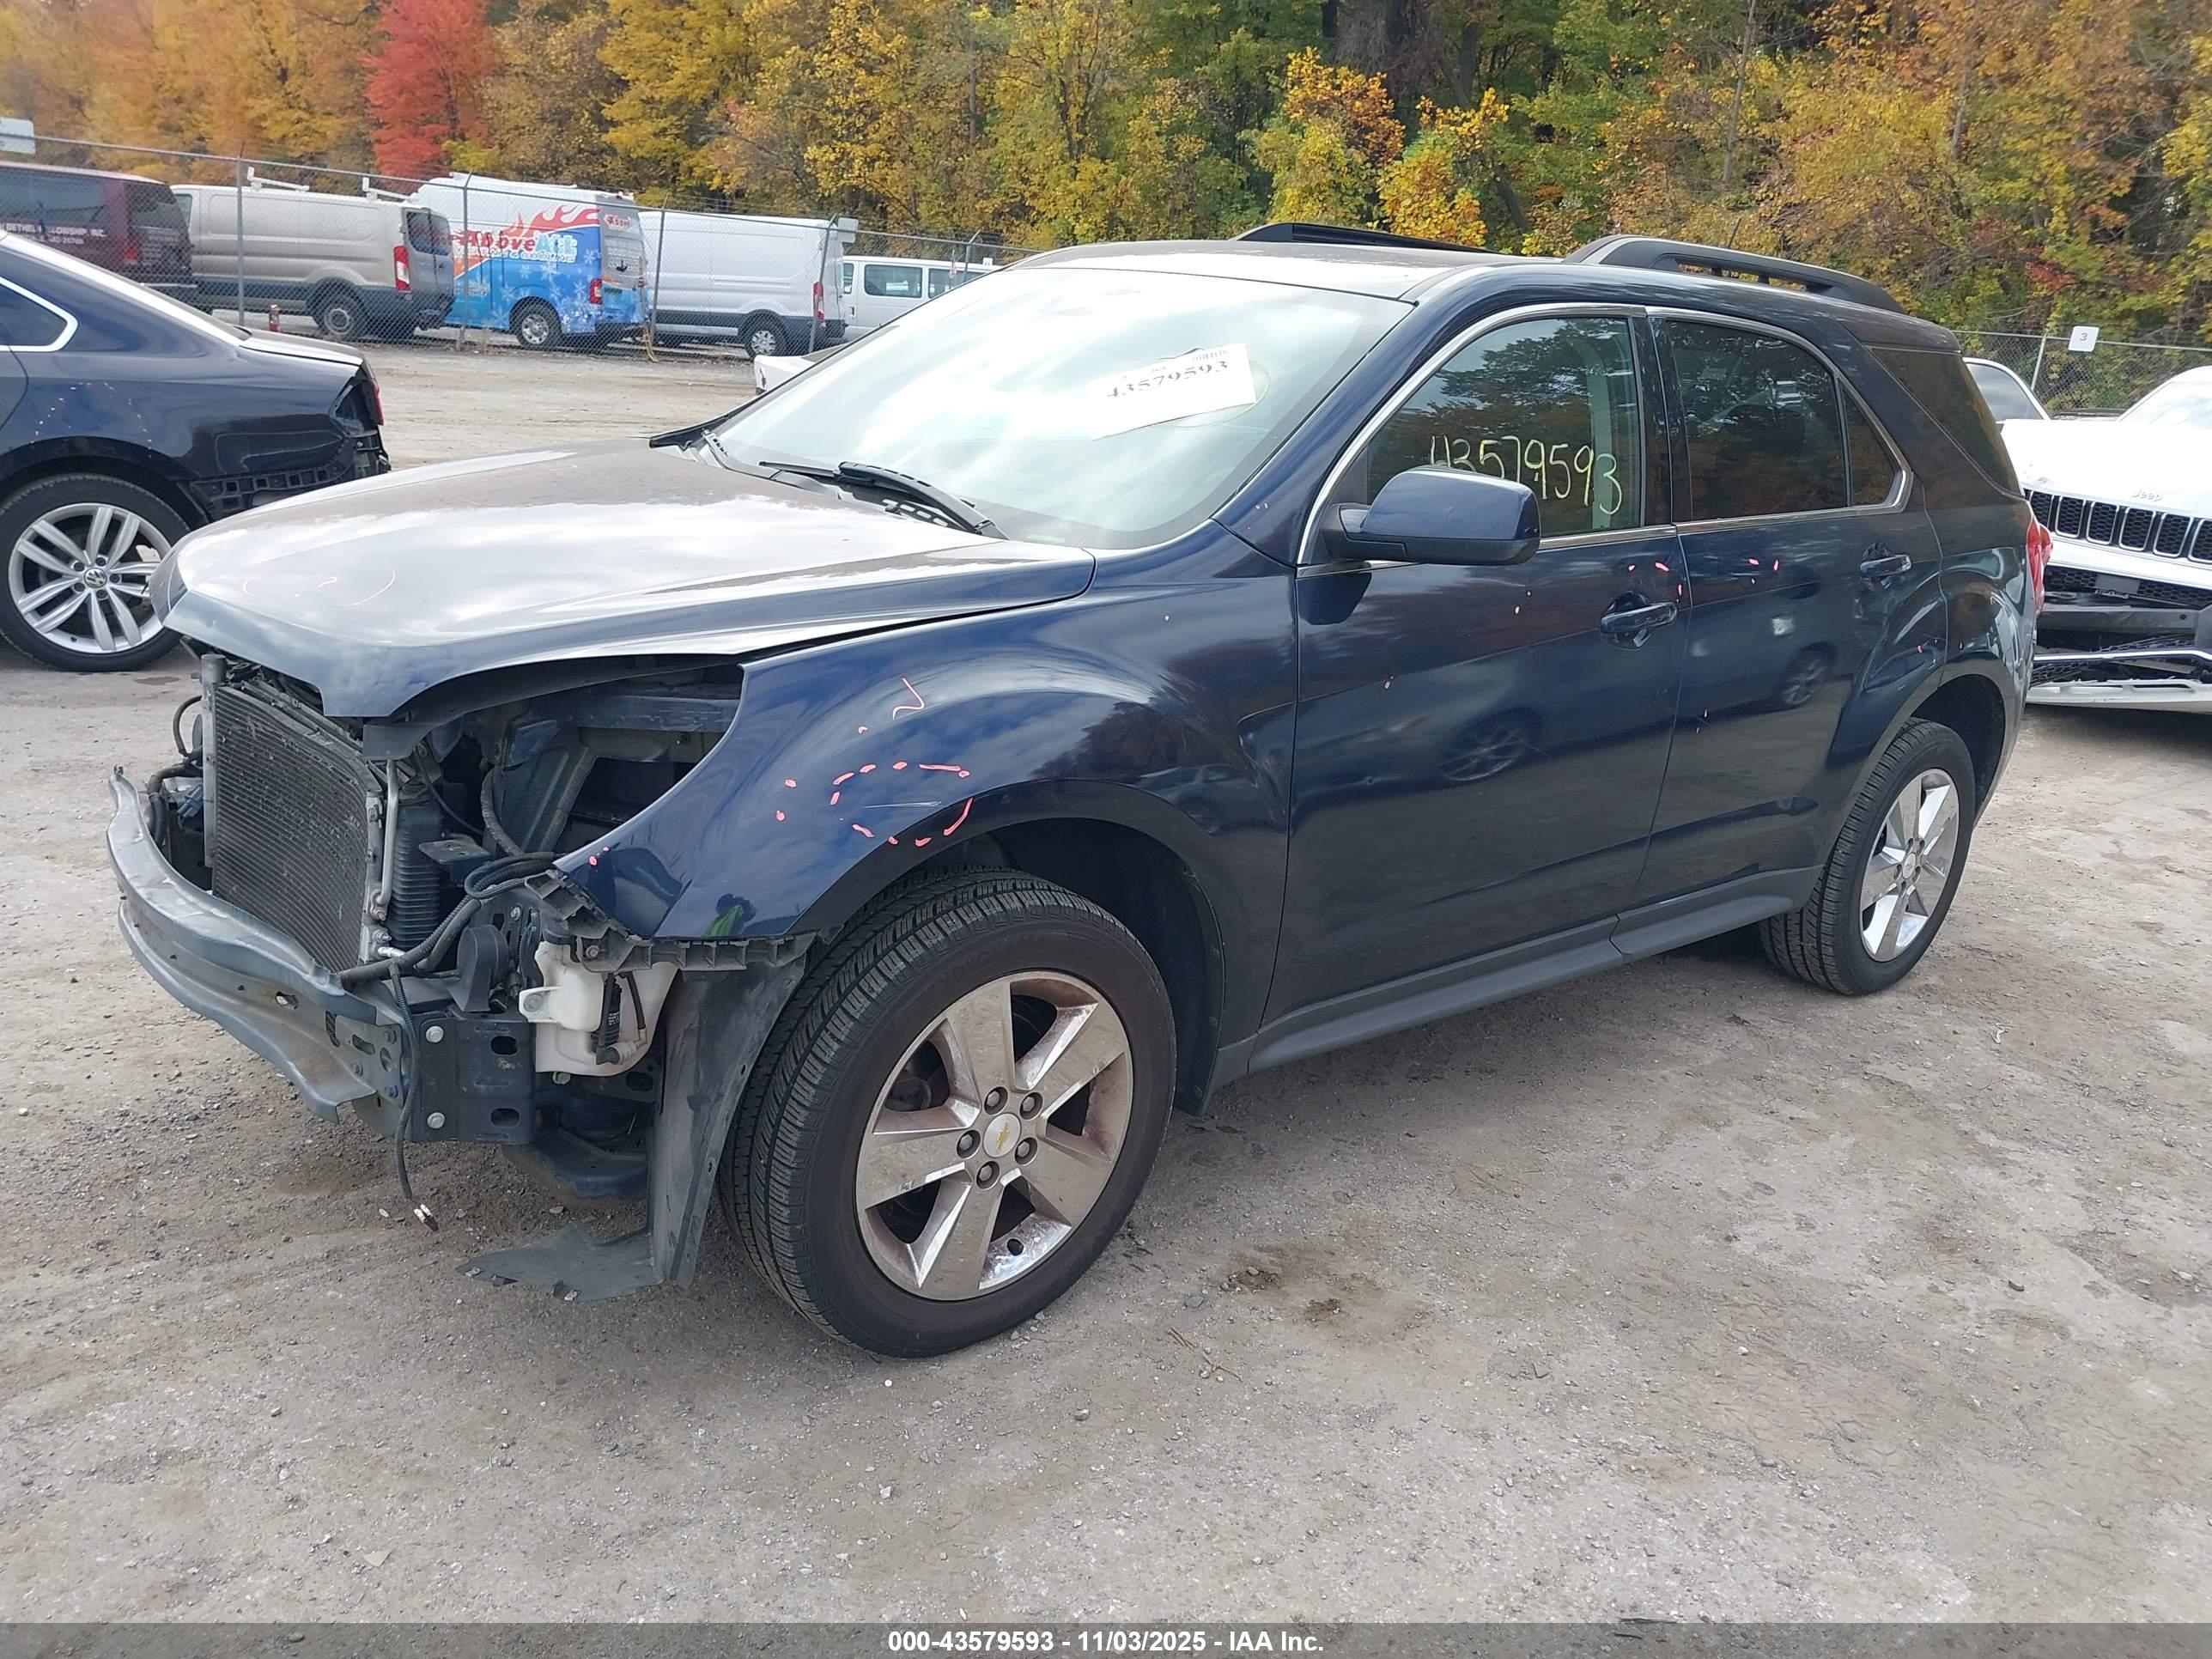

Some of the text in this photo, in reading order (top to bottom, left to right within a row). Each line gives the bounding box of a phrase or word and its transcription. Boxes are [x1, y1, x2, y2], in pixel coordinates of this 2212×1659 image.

[6, 222, 36, 233] BETHEL
[2079, 332, 2088, 341] 3
[1107, 360, 1229, 398] 43579593
[1429, 434, 1623, 515] 43579593
[2130, 488, 2163, 502] Jeep
